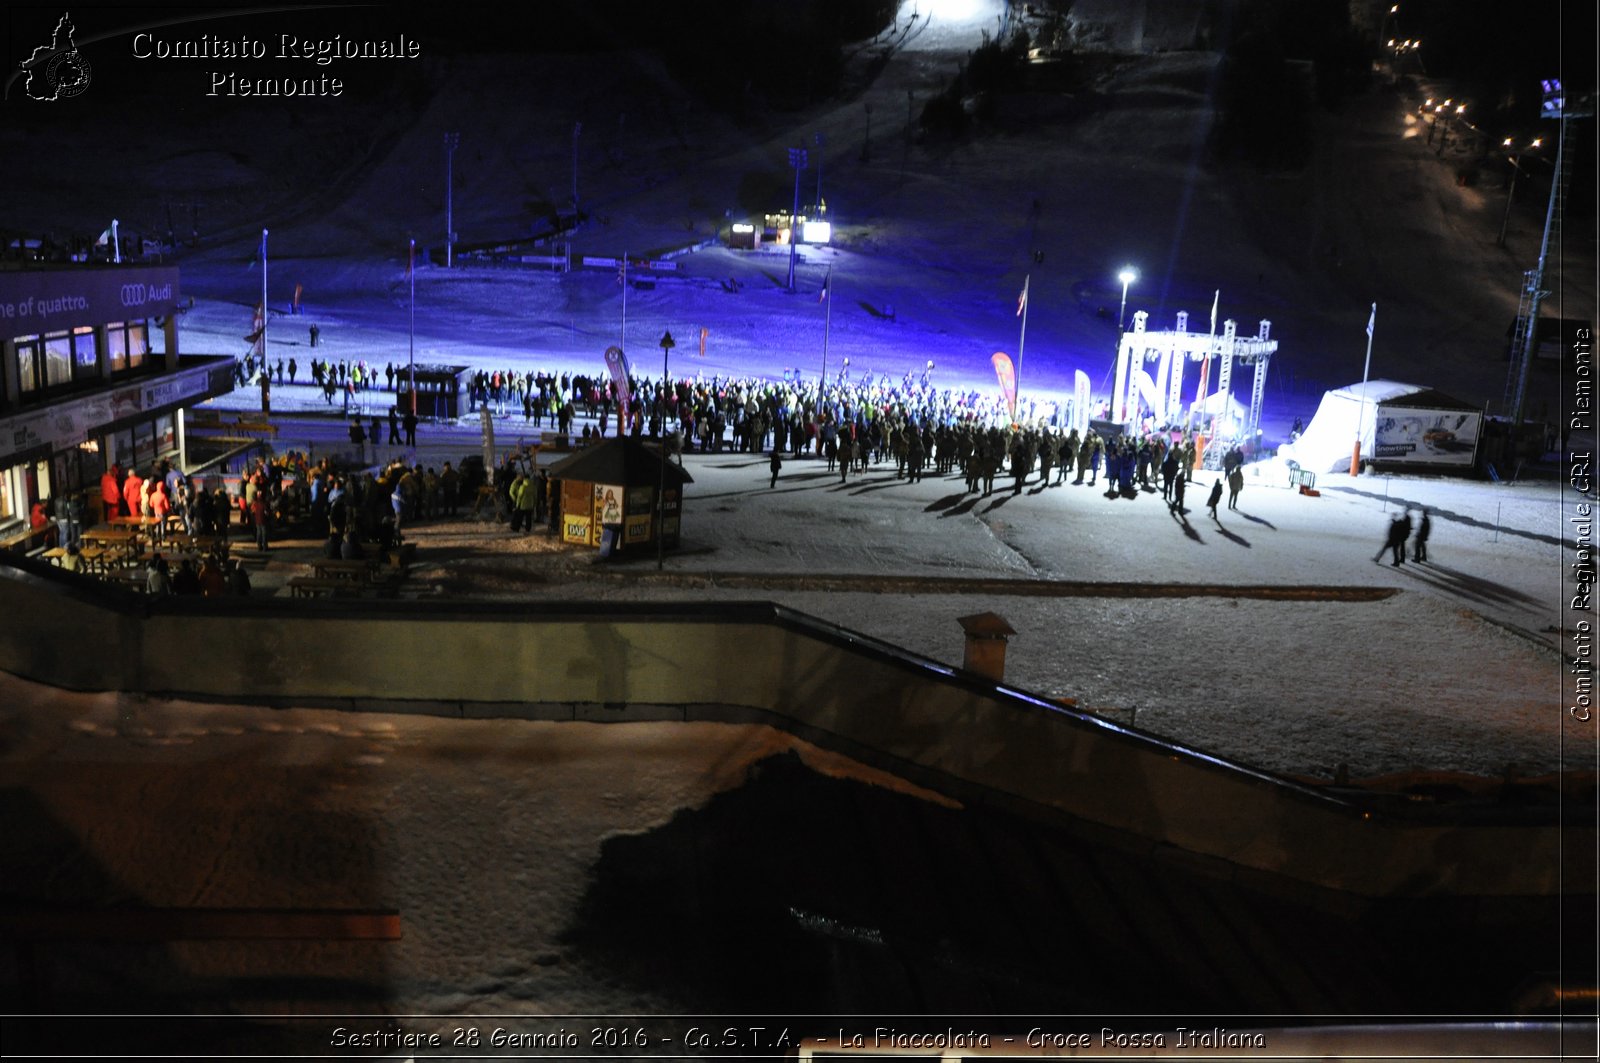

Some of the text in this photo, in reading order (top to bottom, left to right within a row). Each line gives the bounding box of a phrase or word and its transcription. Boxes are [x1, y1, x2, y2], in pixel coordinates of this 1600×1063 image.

[148, 283, 172, 302] Audi
[18, 296, 34, 316] of
[37, 295, 89, 319] quattro.
